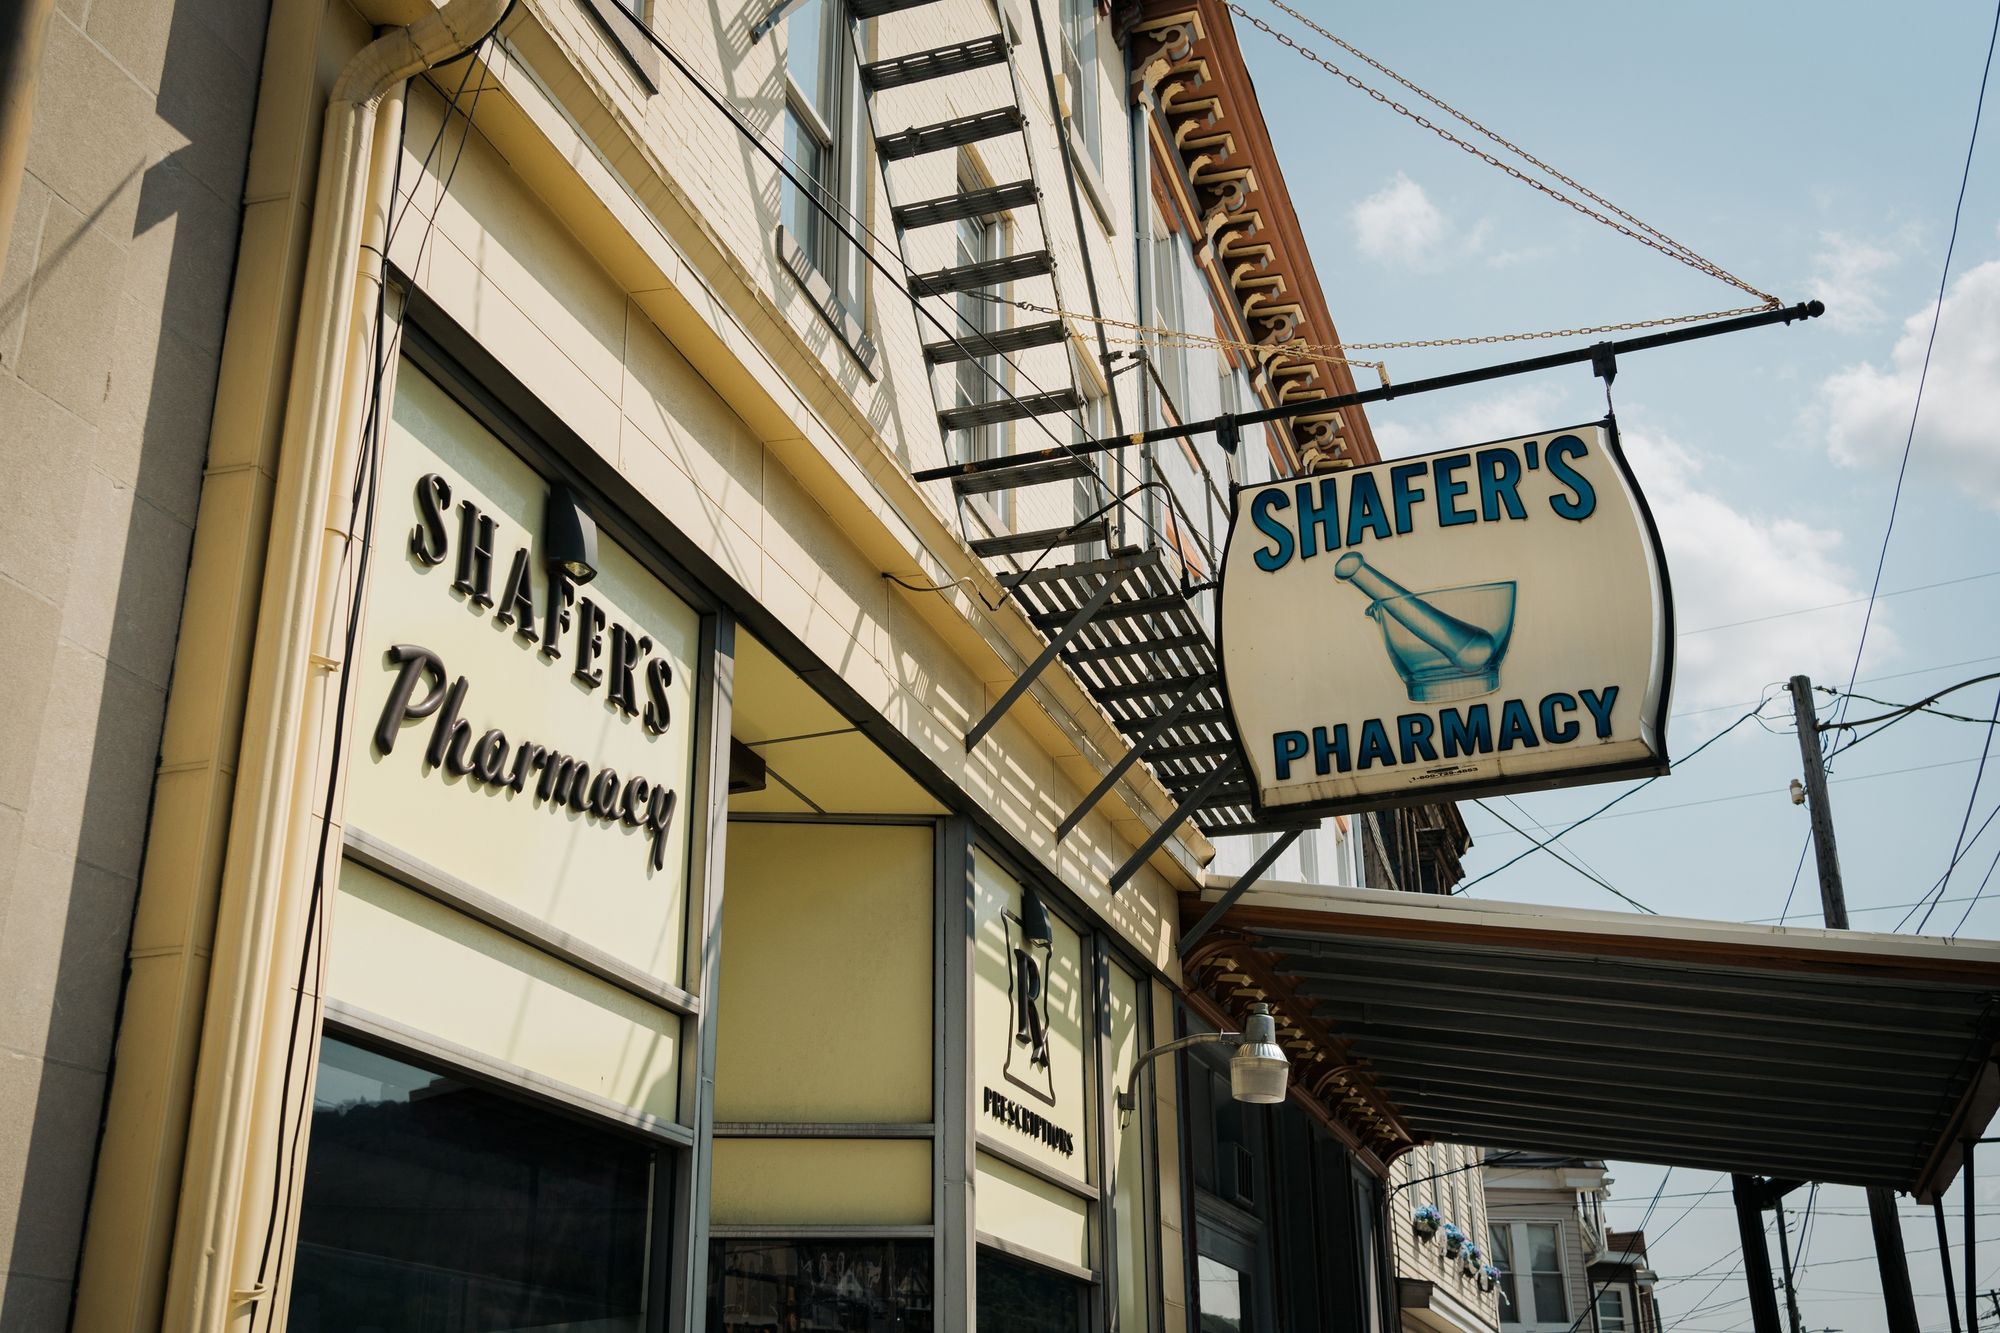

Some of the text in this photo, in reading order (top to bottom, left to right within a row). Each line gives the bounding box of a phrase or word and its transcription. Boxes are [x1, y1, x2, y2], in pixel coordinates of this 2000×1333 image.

[1251, 434, 1597, 573] SHAFER'S
[410, 473, 673, 735] SHAFER'S
[375, 644, 677, 871] Pharmacy
[1273, 686, 1620, 780] PHARMACY
[984, 1086, 1074, 1157] PRESCRIPTIONS
